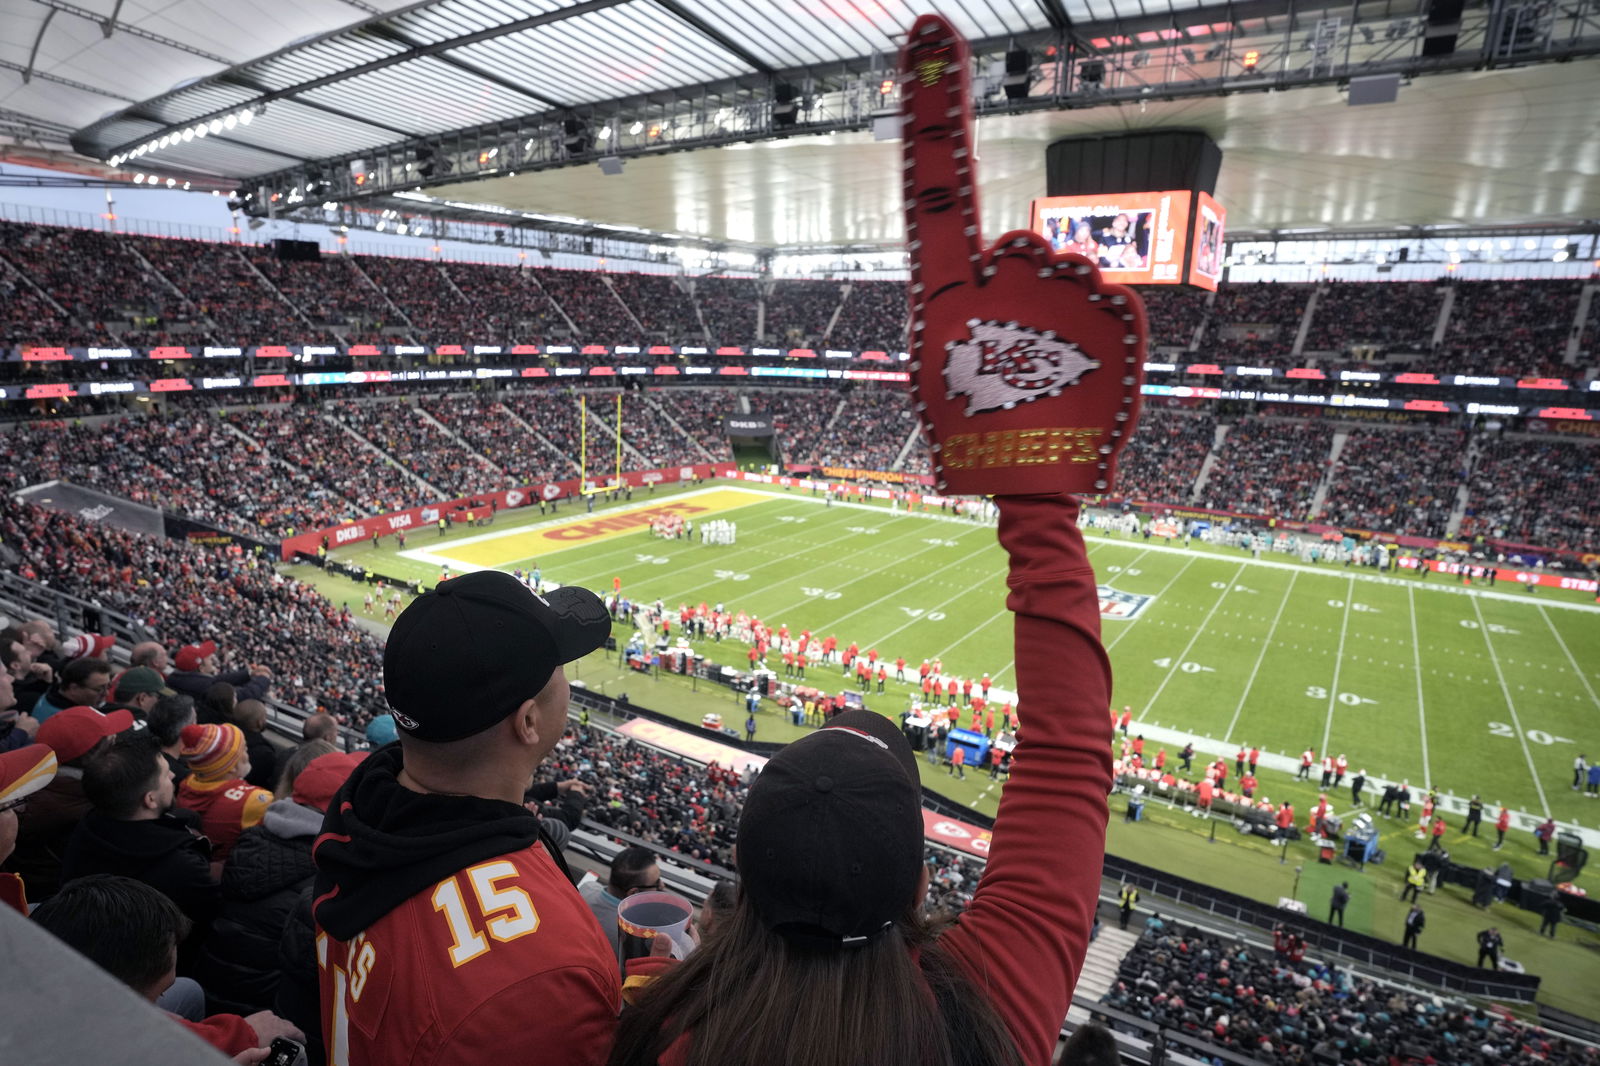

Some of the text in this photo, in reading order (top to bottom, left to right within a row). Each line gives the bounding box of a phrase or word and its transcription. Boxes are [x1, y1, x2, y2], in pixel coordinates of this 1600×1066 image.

[943, 427, 1104, 470] CHIEFS
[822, 467, 854, 479] CHIEFS
[387, 513, 412, 529] VISA
[336, 526, 358, 543] DKB
[1153, 657, 1200, 674] 40
[1305, 685, 1361, 706] 30
[1488, 721, 1555, 746] 20
[431, 860, 541, 968] 15
